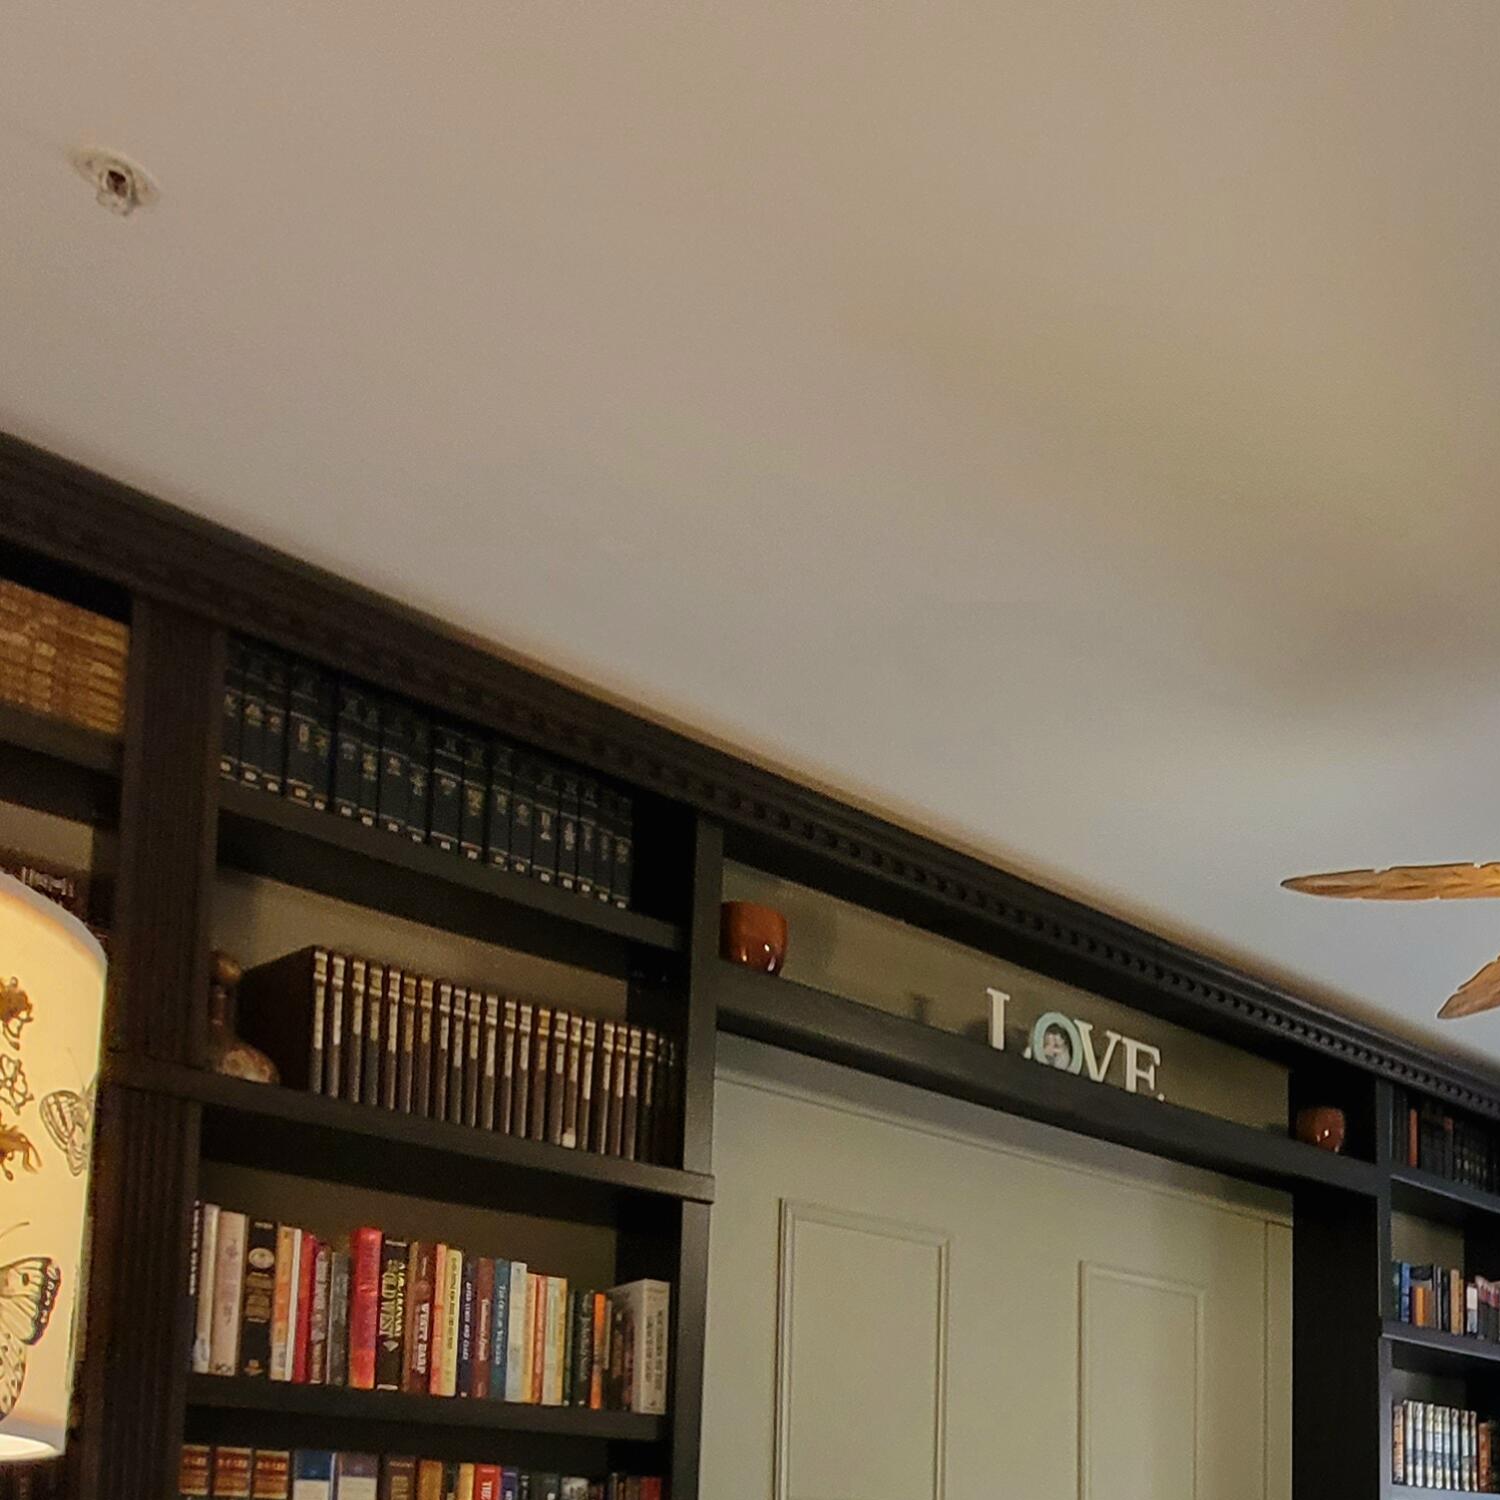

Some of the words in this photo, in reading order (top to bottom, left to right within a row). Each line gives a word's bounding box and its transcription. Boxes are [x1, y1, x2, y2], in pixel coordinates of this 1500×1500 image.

[986, 986, 1165, 1101] LOVE
[381, 1272, 398, 1299] OLD
[379, 1299, 397, 1338] WEST
[418, 1302, 430, 1342] WYATT
[415, 1342, 428, 1374] EARP
[481, 1480, 492, 1500] THE
